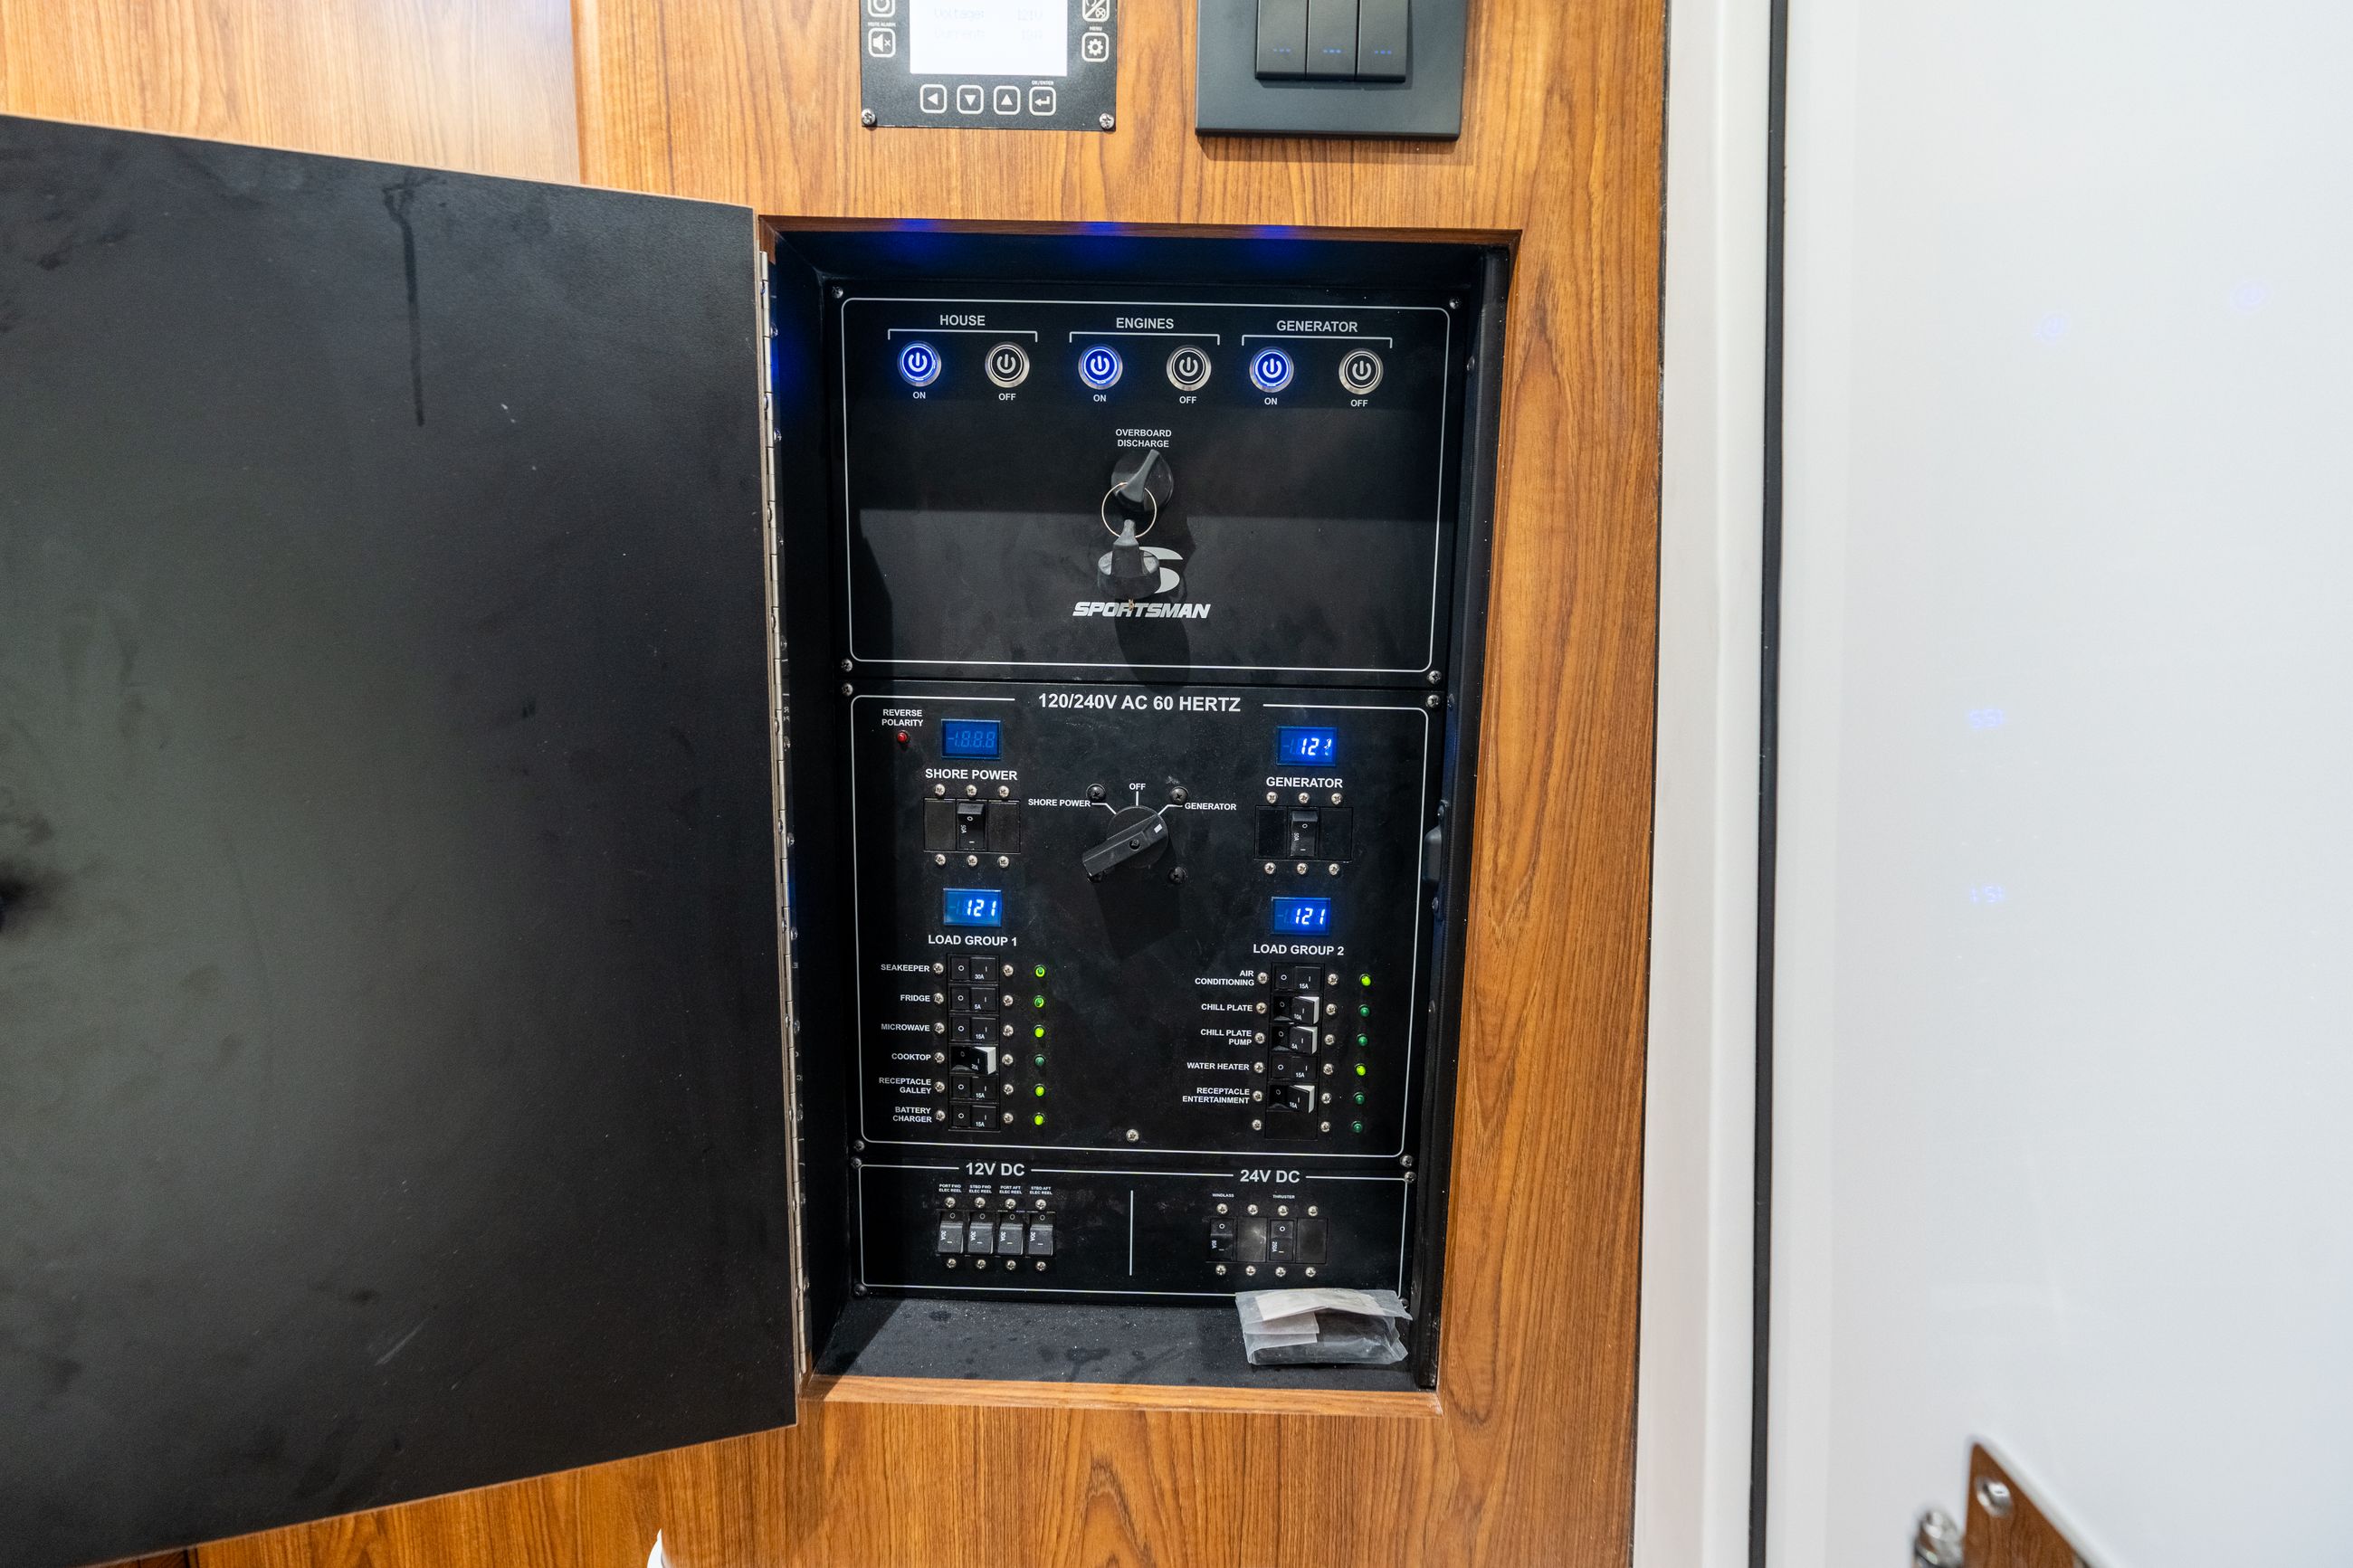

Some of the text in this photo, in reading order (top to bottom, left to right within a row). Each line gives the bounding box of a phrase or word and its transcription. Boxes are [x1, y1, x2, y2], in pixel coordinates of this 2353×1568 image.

[939, 314, 986, 326] HOUSE
[1116, 317, 1174, 329] ENGINES
[1277, 320, 1358, 333] GENERATOR
[913, 391, 926, 399] ON
[998, 393, 1016, 401] OFF
[1093, 394, 1106, 403] ON
[1179, 395, 1197, 404] OFF
[1264, 397, 1277, 405] ON
[1350, 399, 1368, 408] OFF
[1115, 428, 1172, 438] OVERBOARD
[1117, 438, 1169, 448] DISCHARGE
[1072, 601, 1211, 619] SPORTSMAN
[1038, 693, 1241, 712] 120/240V AC 60 HERTZ
[882, 708, 923, 717] REVERSE
[881, 718, 924, 727] POLARITY
[925, 768, 1018, 781] SHORE POWER
[1129, 783, 1146, 791] OFF
[1266, 776, 1343, 789] GENERATOR
[1028, 798, 1091, 808] SHORE POWER
[1184, 802, 1237, 811] GENERATOR
[966, 899, 997, 917] 121
[1295, 908, 1326, 925] 121
[928, 935, 1017, 946] LOAD GROUP 1
[1253, 944, 1345, 956] LOAD GROUP 2
[881, 964, 930, 973] SEAKEEPER
[1195, 977, 1255, 986] CONDITIONING
[900, 994, 931, 1003] FRIDGE
[1201, 1003, 1253, 1012] CHILL PLATE
[881, 1023, 930, 1032] MICROWAVE
[1200, 1028, 1253, 1037] CHILL PLATE
[1228, 1038, 1253, 1046] PUMP
[891, 1053, 931, 1061] COOKTOP
[1186, 1062, 1250, 1071] WATER HEATER
[879, 1077, 932, 1085] RECEPTACLE
[899, 1087, 932, 1095] GALLEY
[1196, 1087, 1250, 1096] RECEPTACLE
[1182, 1096, 1250, 1104] ENTERTAINMENT
[895, 1106, 931, 1114] BATTERY
[892, 1115, 932, 1123] CHARGER
[966, 1162, 1025, 1176] 12V DC
[1240, 1169, 1300, 1183] 24V DC
